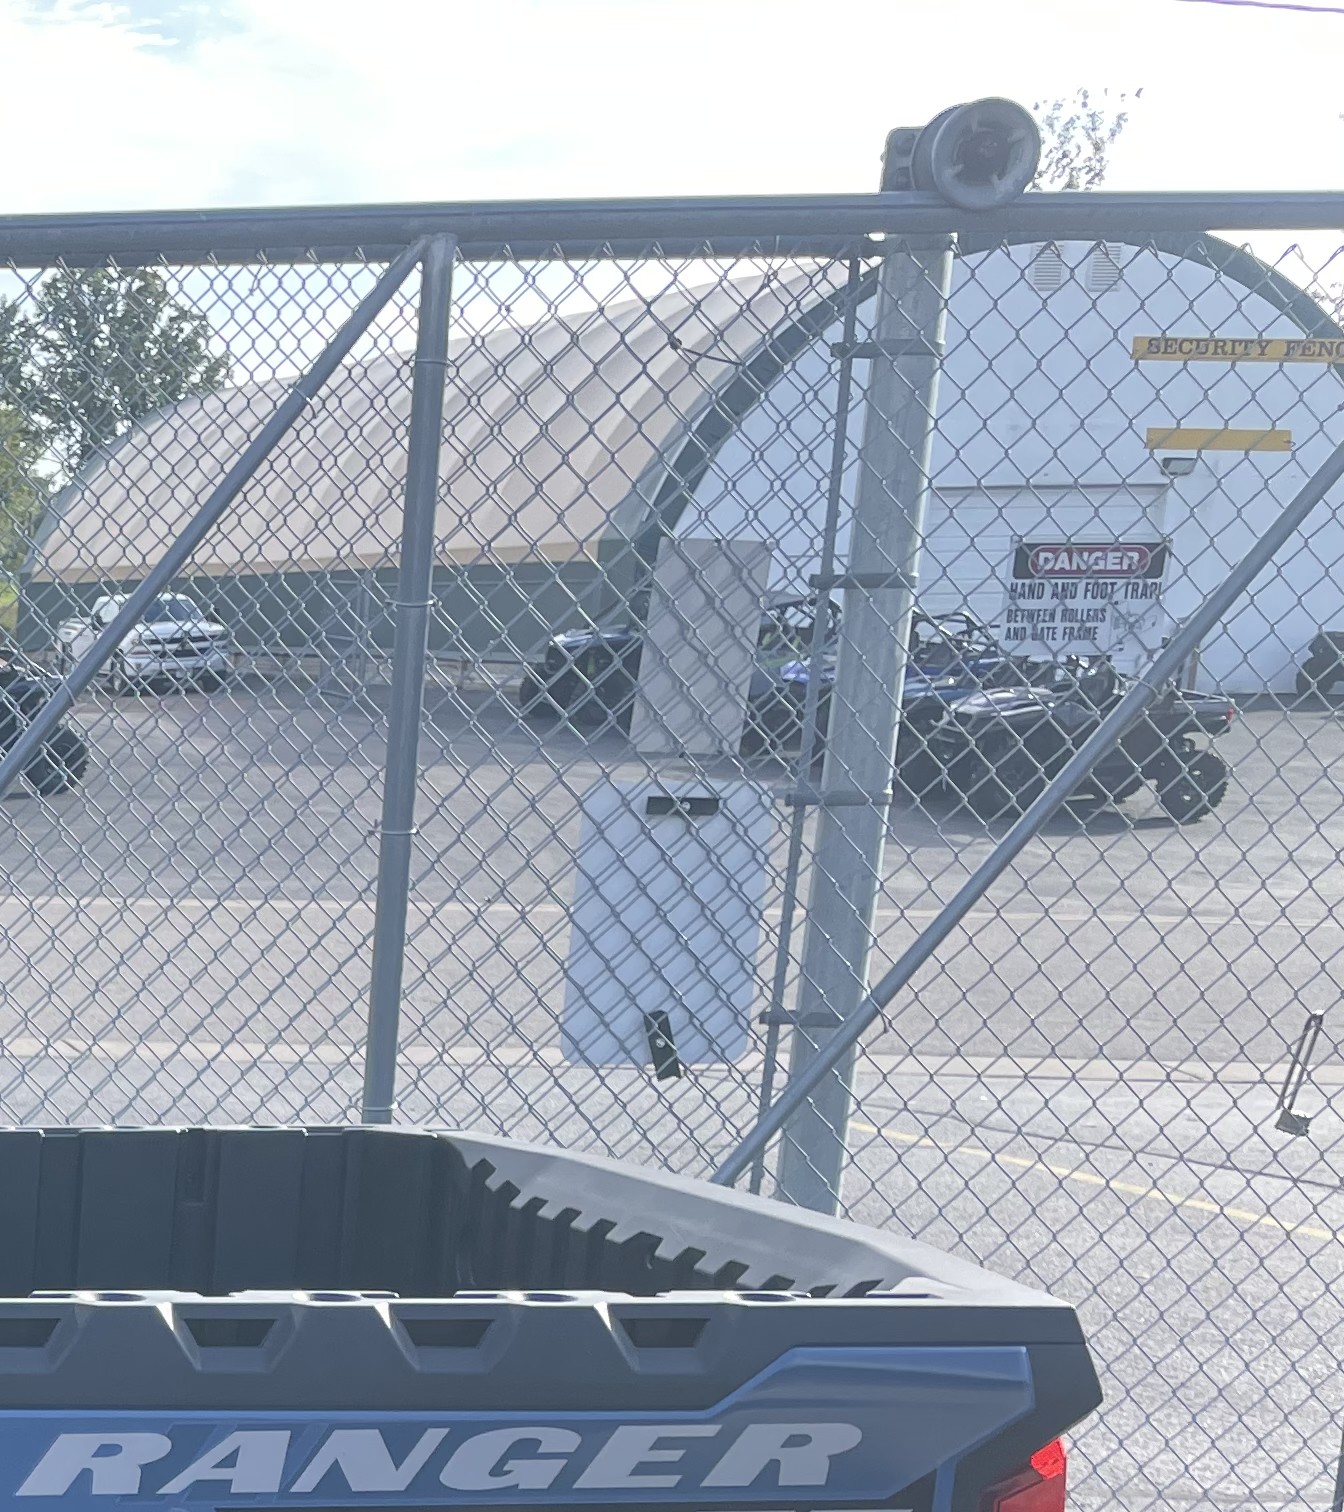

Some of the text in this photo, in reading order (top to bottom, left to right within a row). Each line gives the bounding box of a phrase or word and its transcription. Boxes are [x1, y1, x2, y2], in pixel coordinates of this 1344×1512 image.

[1147, 337, 1273, 356] SECURITY
[1037, 551, 1140, 571] DANGER
[1009, 582, 1045, 600] HAND
[1050, 582, 1079, 600] AND
[1084, 582, 1118, 600] FOOT
[1006, 608, 1107, 624] BETWEEN ROLLERS
[1004, 626, 1027, 641] AND
[1062, 626, 1099, 641] FRAME
[15, 1423, 863, 1496] RANGER
